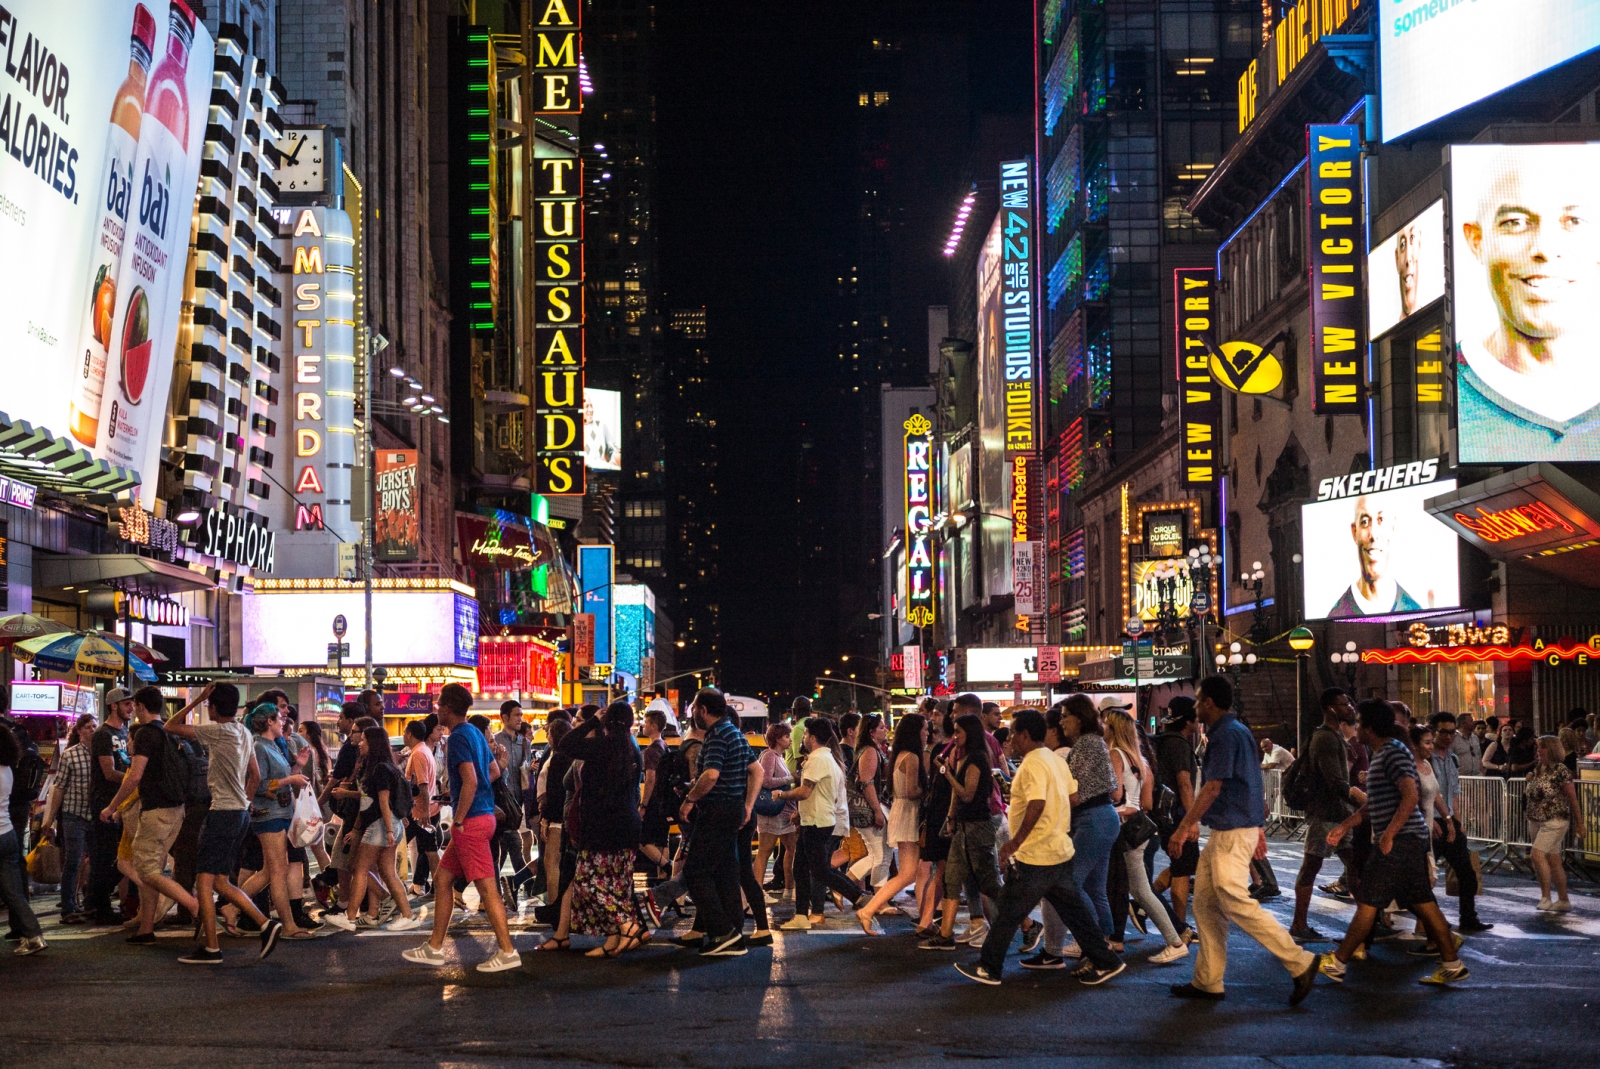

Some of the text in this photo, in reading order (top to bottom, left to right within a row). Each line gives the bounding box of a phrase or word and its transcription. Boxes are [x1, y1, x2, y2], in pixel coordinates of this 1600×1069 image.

[0, 92, 78, 205] ALORIES.
[288, 132, 297, 141] 12
[1002, 162, 1029, 208] NEW
[139, 157, 169, 241] bai
[103, 216, 126, 241] ANTIOXIDA
[270, 209, 292, 224] EW
[1004, 211, 1029, 260] 42
[134, 232, 168, 270] ANTIOXIDANT
[131, 252, 157, 284] INFUSION
[1319, 135, 1357, 403] NEW VICTORY
[540, 159, 577, 493] TUSSAUD'S
[1004, 291, 1032, 380] STUDIOS
[293, 209, 325, 532] AMSTERDAM
[1184, 277, 1213, 482] NEW VICTORY
[1006, 390, 1032, 442] DUKE
[376, 467, 417, 492] JERSEY
[1317, 457, 1439, 501] SKECHERS
[10, 486, 36, 507] PRIME
[381, 488, 411, 511] BOYS
[907, 441, 931, 599] REGAL
[1154, 525, 1176, 534] CIRQUE
[1454, 500, 1575, 542] Subway
[204, 507, 276, 574] SEPHORA
[471, 539, 513, 556] Madame
[1151, 533, 1181, 542] DU SOLEIL
[1016, 557, 1031, 566] NEW
[1016, 581, 1033, 598] 25
[576, 641, 588, 655] 25
[1152, 647, 1184, 656] CTORY
[1535, 638, 1545, 649] A
[78, 662, 121, 676] SABRET
[1041, 660, 1058, 672] 25
[1549, 654, 1560, 666] C
[1578, 654, 1587, 665] E
